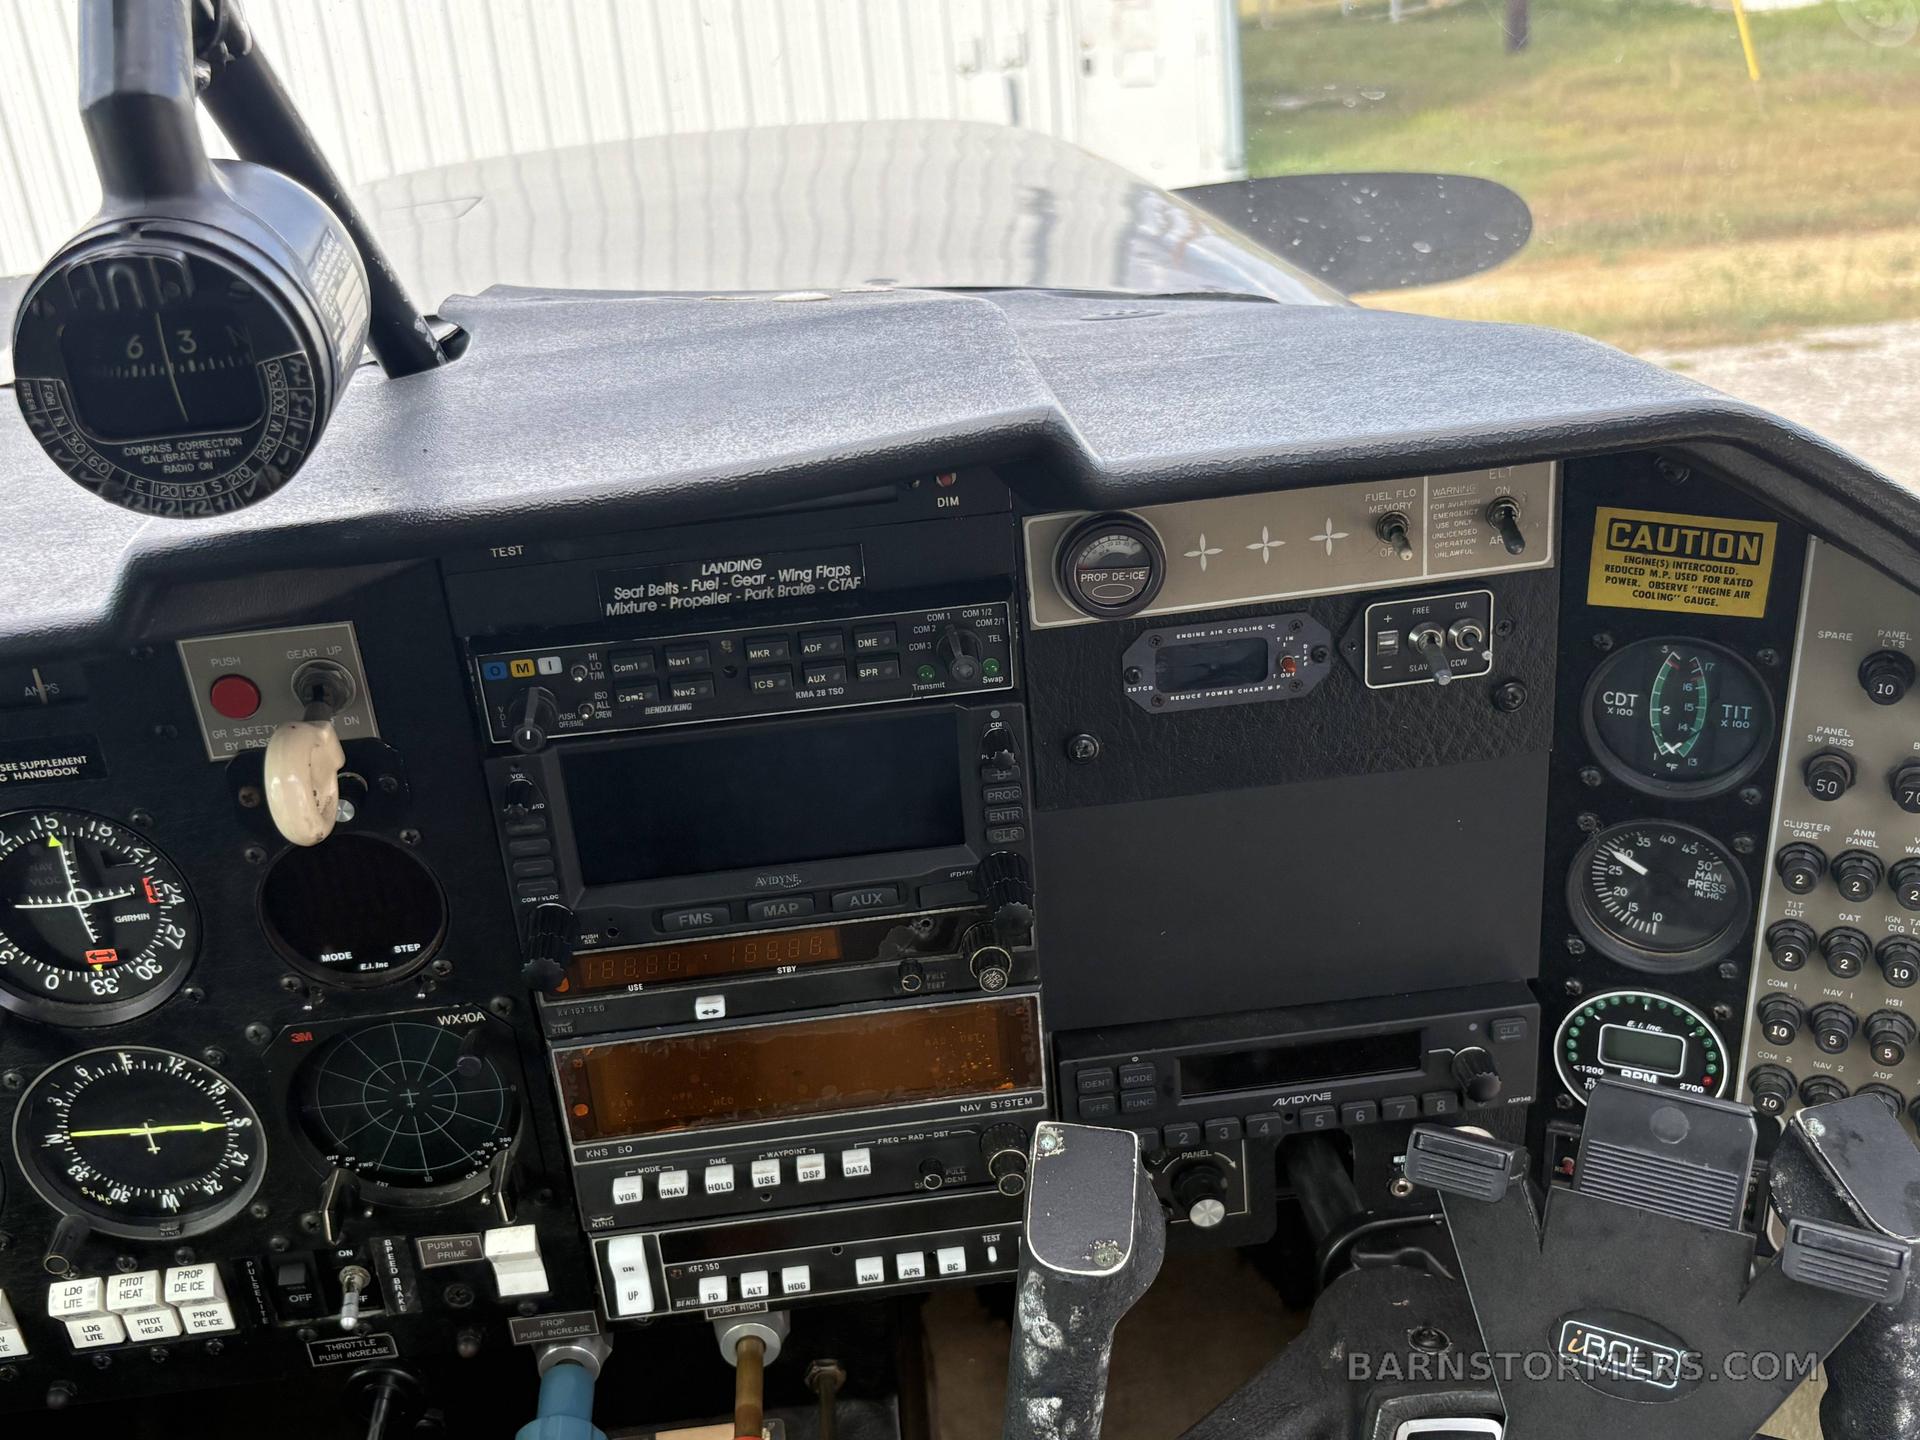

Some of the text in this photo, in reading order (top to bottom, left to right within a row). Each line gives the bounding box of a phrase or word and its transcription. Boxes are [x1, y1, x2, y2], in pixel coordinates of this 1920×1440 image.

[124, 437, 242, 457] COMPASS CORRECTION
[142, 448, 231, 463] CALIBRATE WITH
[163, 461, 213, 473] RADIO ON
[1433, 484, 1476, 496] WARNING
[1495, 486, 1510, 495] ON
[1365, 489, 1416, 502] FUEL FLO
[937, 497, 959, 507] DIM
[1448, 499, 1480, 508] AVIATION
[1369, 502, 1412, 514] MEMORY
[1433, 509, 1479, 520] EMERGENCY
[1432, 529, 1477, 539] UNLICENSED
[1435, 538, 1477, 548] OPERATION
[1609, 522, 1760, 561] CAUTION
[490, 546, 524, 557] TEST
[1435, 549, 1473, 558] UNLAWFUL
[702, 558, 762, 575] LANDING
[1624, 556, 1739, 575] ENGINE(S) INTERCOOLED.
[1081, 571, 1145, 582] PROP DE-ICE
[1605, 565, 1753, 587] REDUCED M.P. USED FOR RATED
[614, 565, 850, 600] Seat Belts Fuel Gear Wing Flaps
[1605, 576, 1750, 599] POWER. OBSERVE "ENGINE AIR
[606, 577, 861, 616] Mixture Propeller Park Brake CTAF
[1633, 590, 1718, 606] COOLING" GAUGE.
[1412, 606, 1429, 614] FREE
[1817, 631, 1853, 641] SPARE
[1878, 630, 1912, 640] PANEL
[858, 639, 878, 647] DME
[1882, 640, 1905, 648] LTS
[287, 646, 342, 659] GEAR UP
[804, 644, 822, 653] ADF
[750, 650, 770, 658] MKR
[211, 656, 241, 667] PUSH
[669, 657, 691, 666] Nav1
[1451, 659, 1467, 667] CCW
[613, 663, 638, 672] Com1
[860, 669, 878, 677] SPR
[754, 680, 774, 688] ICS
[807, 675, 826, 683] AUX
[983, 676, 1003, 684] Swap
[912, 682, 945, 692] Transmit
[674, 688, 696, 697] Nav2
[619, 693, 644, 703] Com2
[1603, 692, 1639, 707] CDT
[1722, 704, 1752, 719] TIT
[344, 716, 360, 726] DN
[212, 724, 278, 739] GR SAFETY
[1817, 726, 1851, 737] PANEL
[1829, 737, 1854, 747] BUSS
[20, 756, 87, 771] SUPPLEMENT
[14, 767, 79, 780] HANDBOOK
[1816, 779, 1837, 794] 50
[1784, 819, 1831, 832] CLUSTER
[1793, 831, 1818, 839] GAGE
[1853, 829, 1875, 837] ANN
[1660, 835, 1675, 844] 40
[1846, 837, 1879, 848] PANEL
[1608, 866, 1623, 875] 25
[1695, 871, 1722, 881] MAN
[1613, 887, 1627, 896] 20
[1687, 880, 1726, 893] PRESS
[849, 892, 882, 907] AUX
[763, 903, 798, 917] MAP
[1785, 909, 1804, 917] CDT
[115, 913, 150, 923] GARMIN
[679, 912, 713, 926] FMS
[1839, 913, 1861, 922] OAT
[394, 944, 421, 953] STEP
[321, 952, 352, 962] MODE
[777, 966, 796, 974] STBY
[438, 1011, 486, 1025] WX-10A
[291, 1032, 312, 1043] 3M
[1621, 1069, 1657, 1083] RPM
[1680, 1083, 1704, 1093] 2700
[1273, 1092, 1332, 1106] AVIDYNE
[960, 1098, 1033, 1112] NAV SYSTEM
[767, 1148, 807, 1157] WAYPOINT
[1181, 1150, 1212, 1159] PANEL
[802, 1170, 821, 1179] DSP
[846, 1165, 868, 1174] DATA
[758, 1175, 775, 1184] USE
[708, 1181, 732, 1191] HOLD
[618, 1192, 637, 1201] VOR
[661, 1187, 685, 1196] RNAV
[982, 1234, 1000, 1242] TEST
[427, 1240, 472, 1250] PUSH TO
[338, 1249, 353, 1257] ON
[437, 1249, 467, 1259] PRIME
[178, 1269, 202, 1279] PROP
[904, 1268, 920, 1276] APR
[120, 1276, 143, 1287] PITOT
[862, 1274, 878, 1282] NAV
[64, 1287, 82, 1296] LDG
[748, 1287, 762, 1295] ALT
[788, 1283, 806, 1291] HDG
[120, 1289, 142, 1299] HEAT
[64, 1299, 82, 1308] LITE
[193, 1310, 218, 1318] PROP
[137, 1317, 161, 1325] PITOT
[540, 1319, 565, 1327] PROP
[82, 1325, 100, 1334] LDG
[141, 1325, 164, 1334] HEAT
[520, 1324, 591, 1339] PUSH INCREASE
[86, 1333, 104, 1341] LITE
[325, 1338, 376, 1351] THROTTLE
[318, 1347, 389, 1362] PUSH INCREASE
[1567, 1330, 1668, 1377] iBOLT
